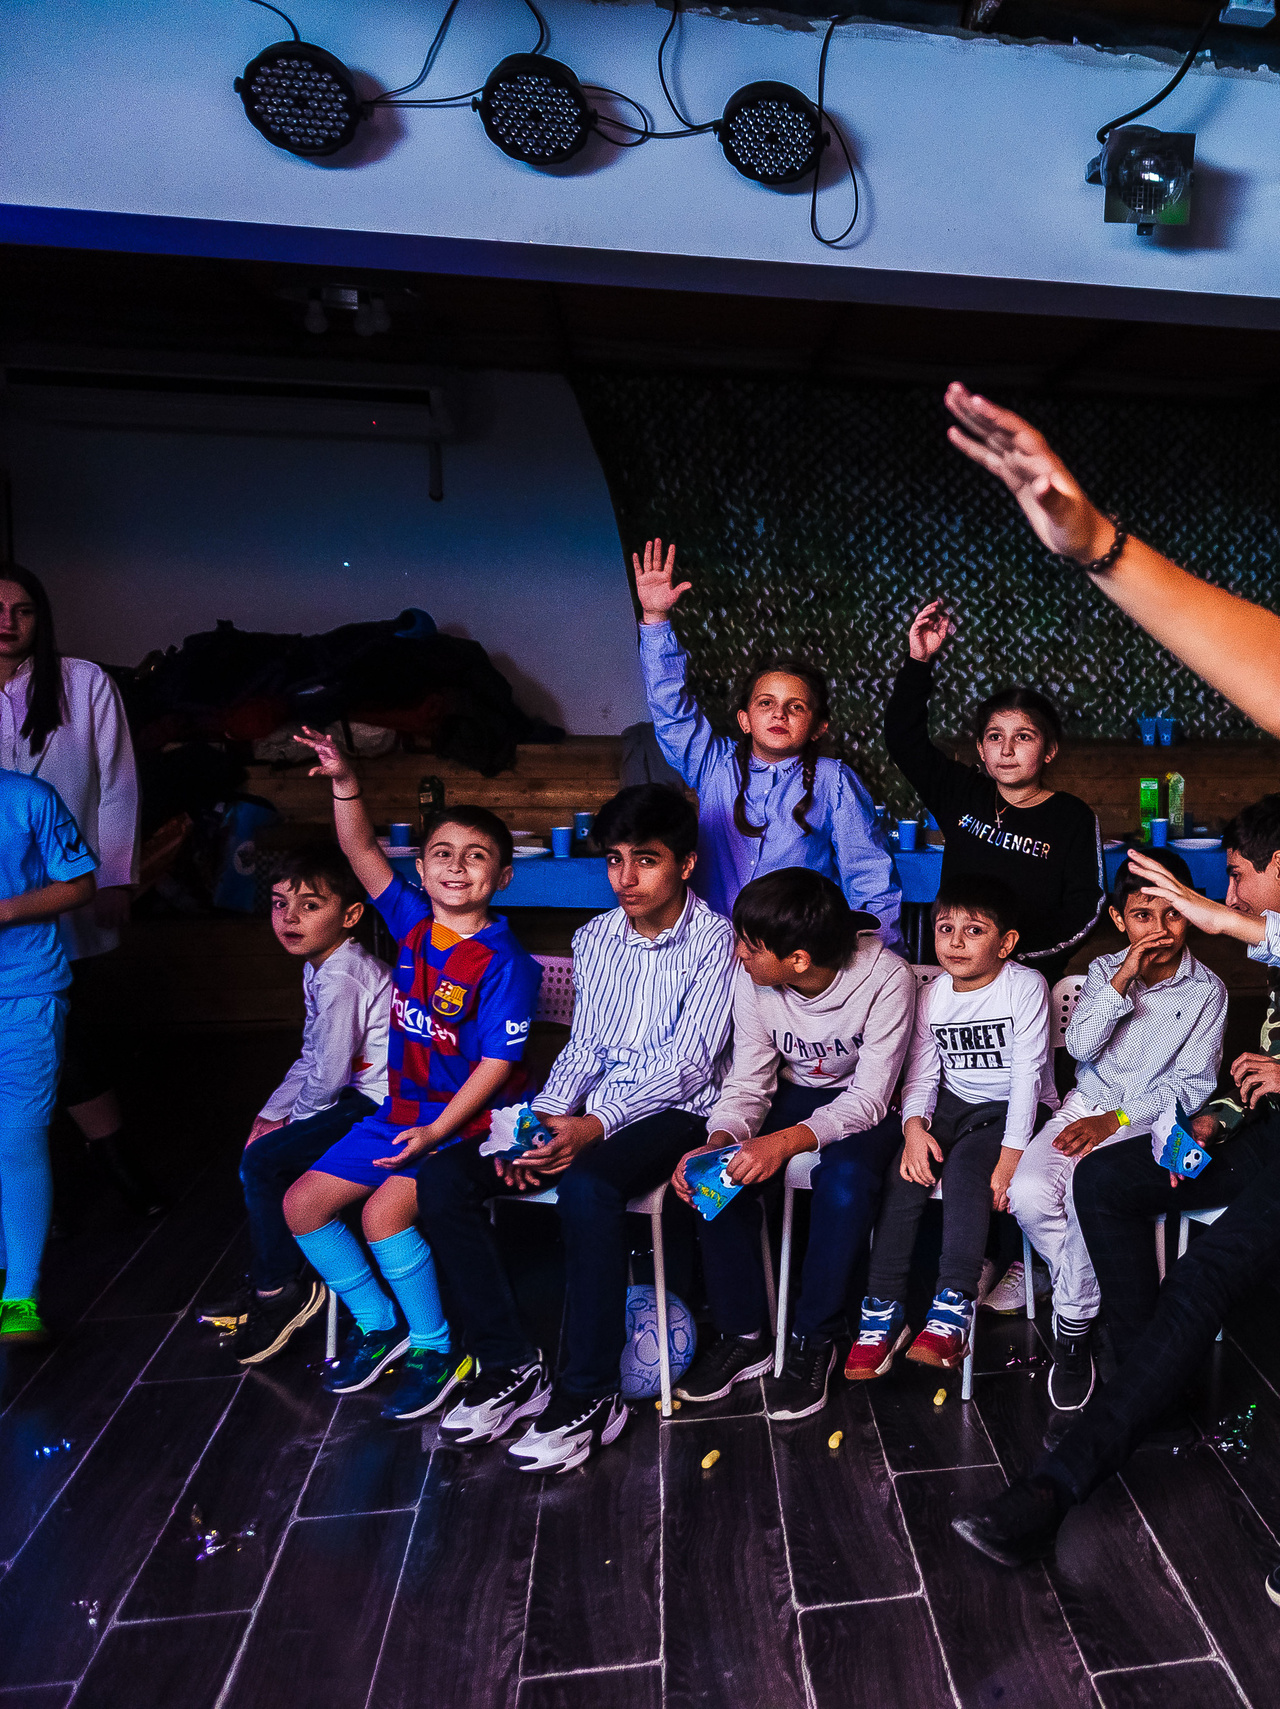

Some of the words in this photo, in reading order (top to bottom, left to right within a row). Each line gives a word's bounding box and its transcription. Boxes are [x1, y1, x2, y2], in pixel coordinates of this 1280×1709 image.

[958, 814, 1051, 859] #INFLUENCER
[505, 1018, 530, 1035] be
[935, 1023, 1006, 1050] STREET
[950, 1053, 998, 1069] WEAR
